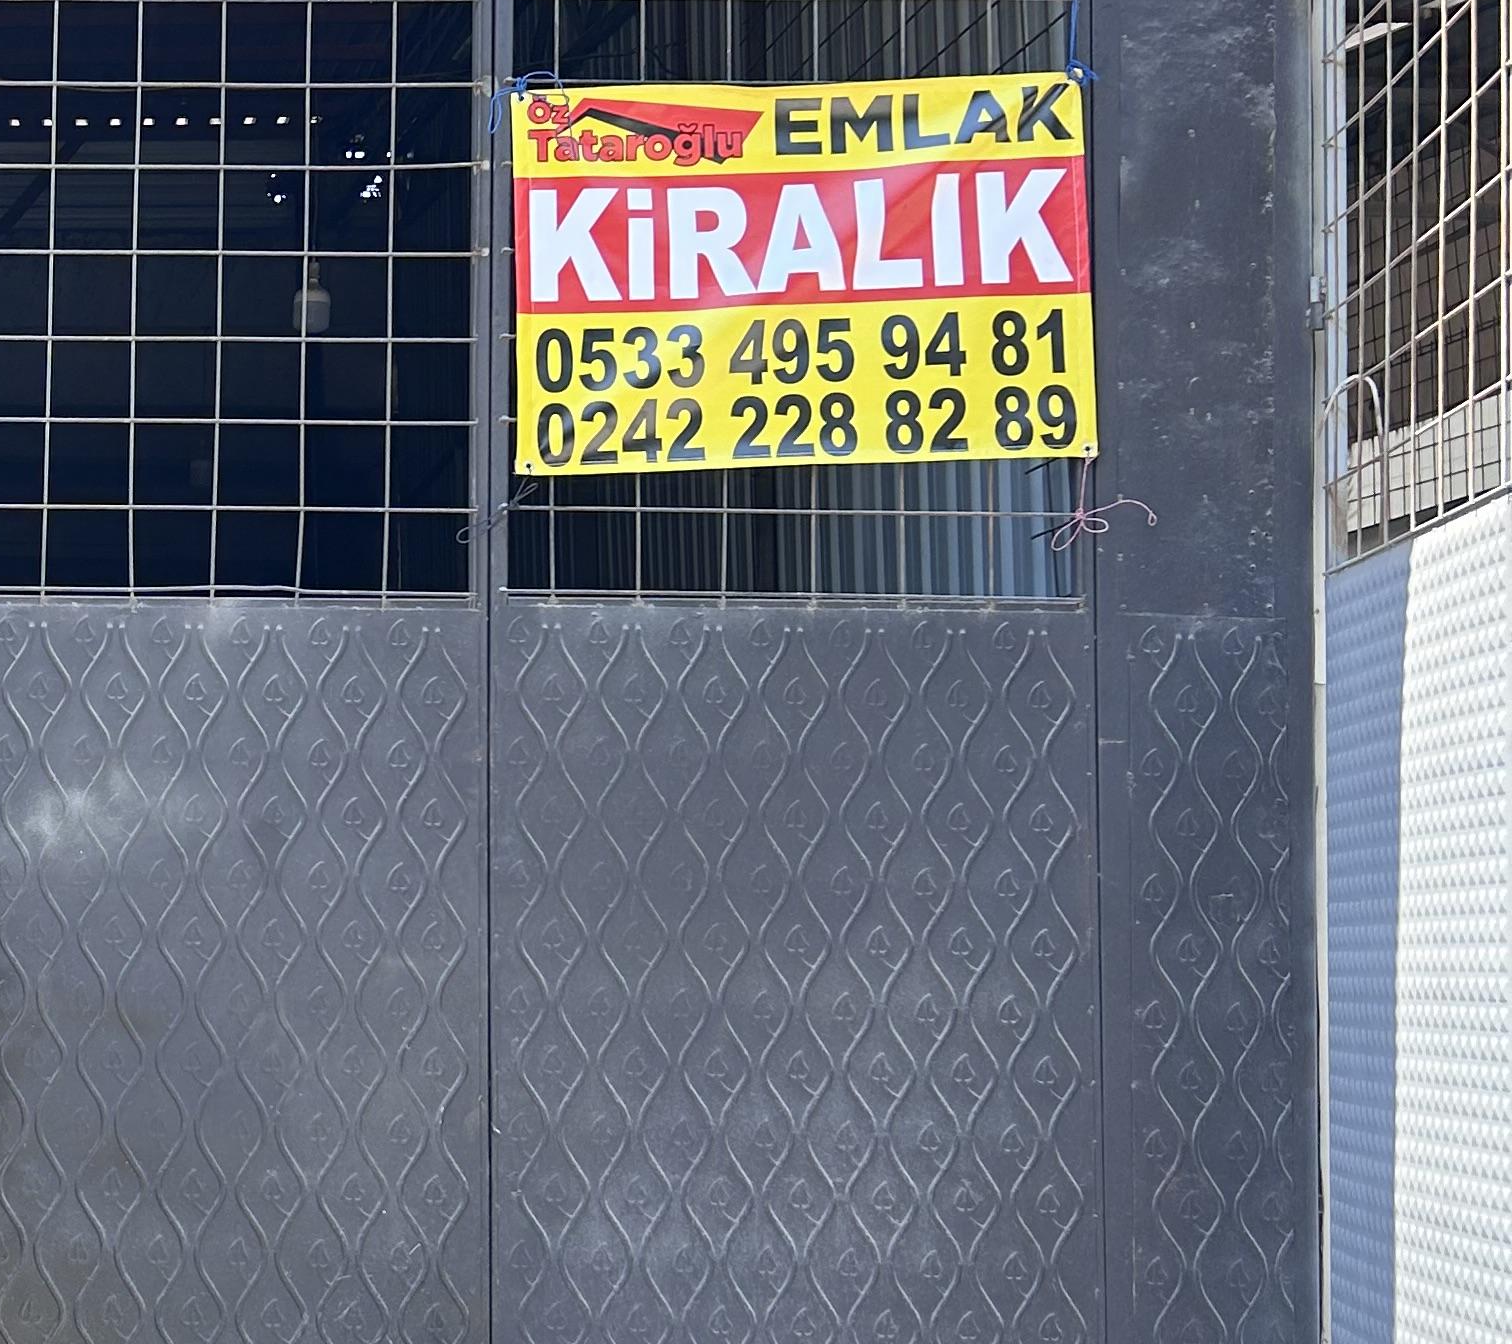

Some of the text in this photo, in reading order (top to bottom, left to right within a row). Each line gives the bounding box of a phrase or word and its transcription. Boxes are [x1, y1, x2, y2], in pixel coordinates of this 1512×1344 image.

[527, 95, 570, 125] Öz
[528, 122, 744, 167] Tataroğlu
[774, 83, 1075, 156] EMLAK
[535, 308, 1067, 394] 0533 495 94 81
[536, 384, 1078, 469] 0242 228 82 89
